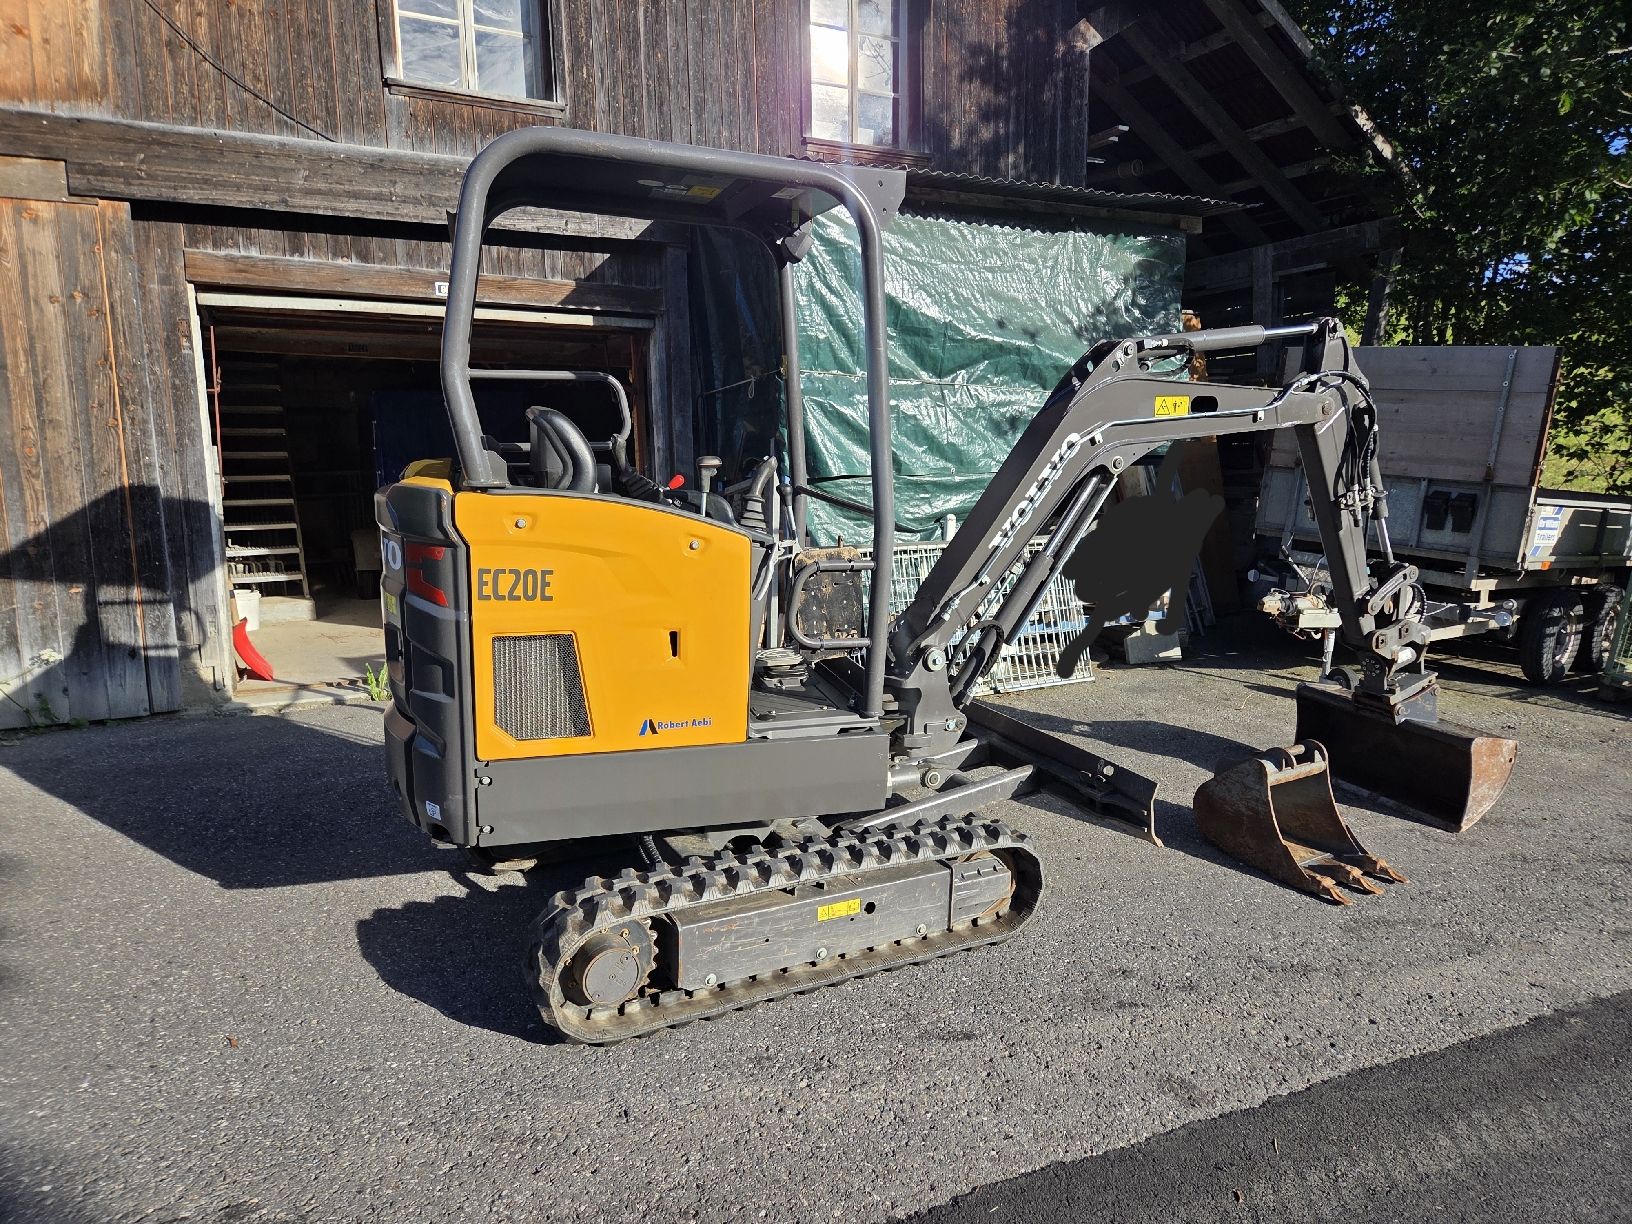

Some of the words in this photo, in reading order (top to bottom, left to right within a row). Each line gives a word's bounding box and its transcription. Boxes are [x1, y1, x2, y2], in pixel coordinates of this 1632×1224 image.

[988, 432, 1082, 550] VOLVO
[477, 568, 553, 602] EC20E
[657, 720, 689, 730] Robert
[691, 717, 712, 727] Aebi
